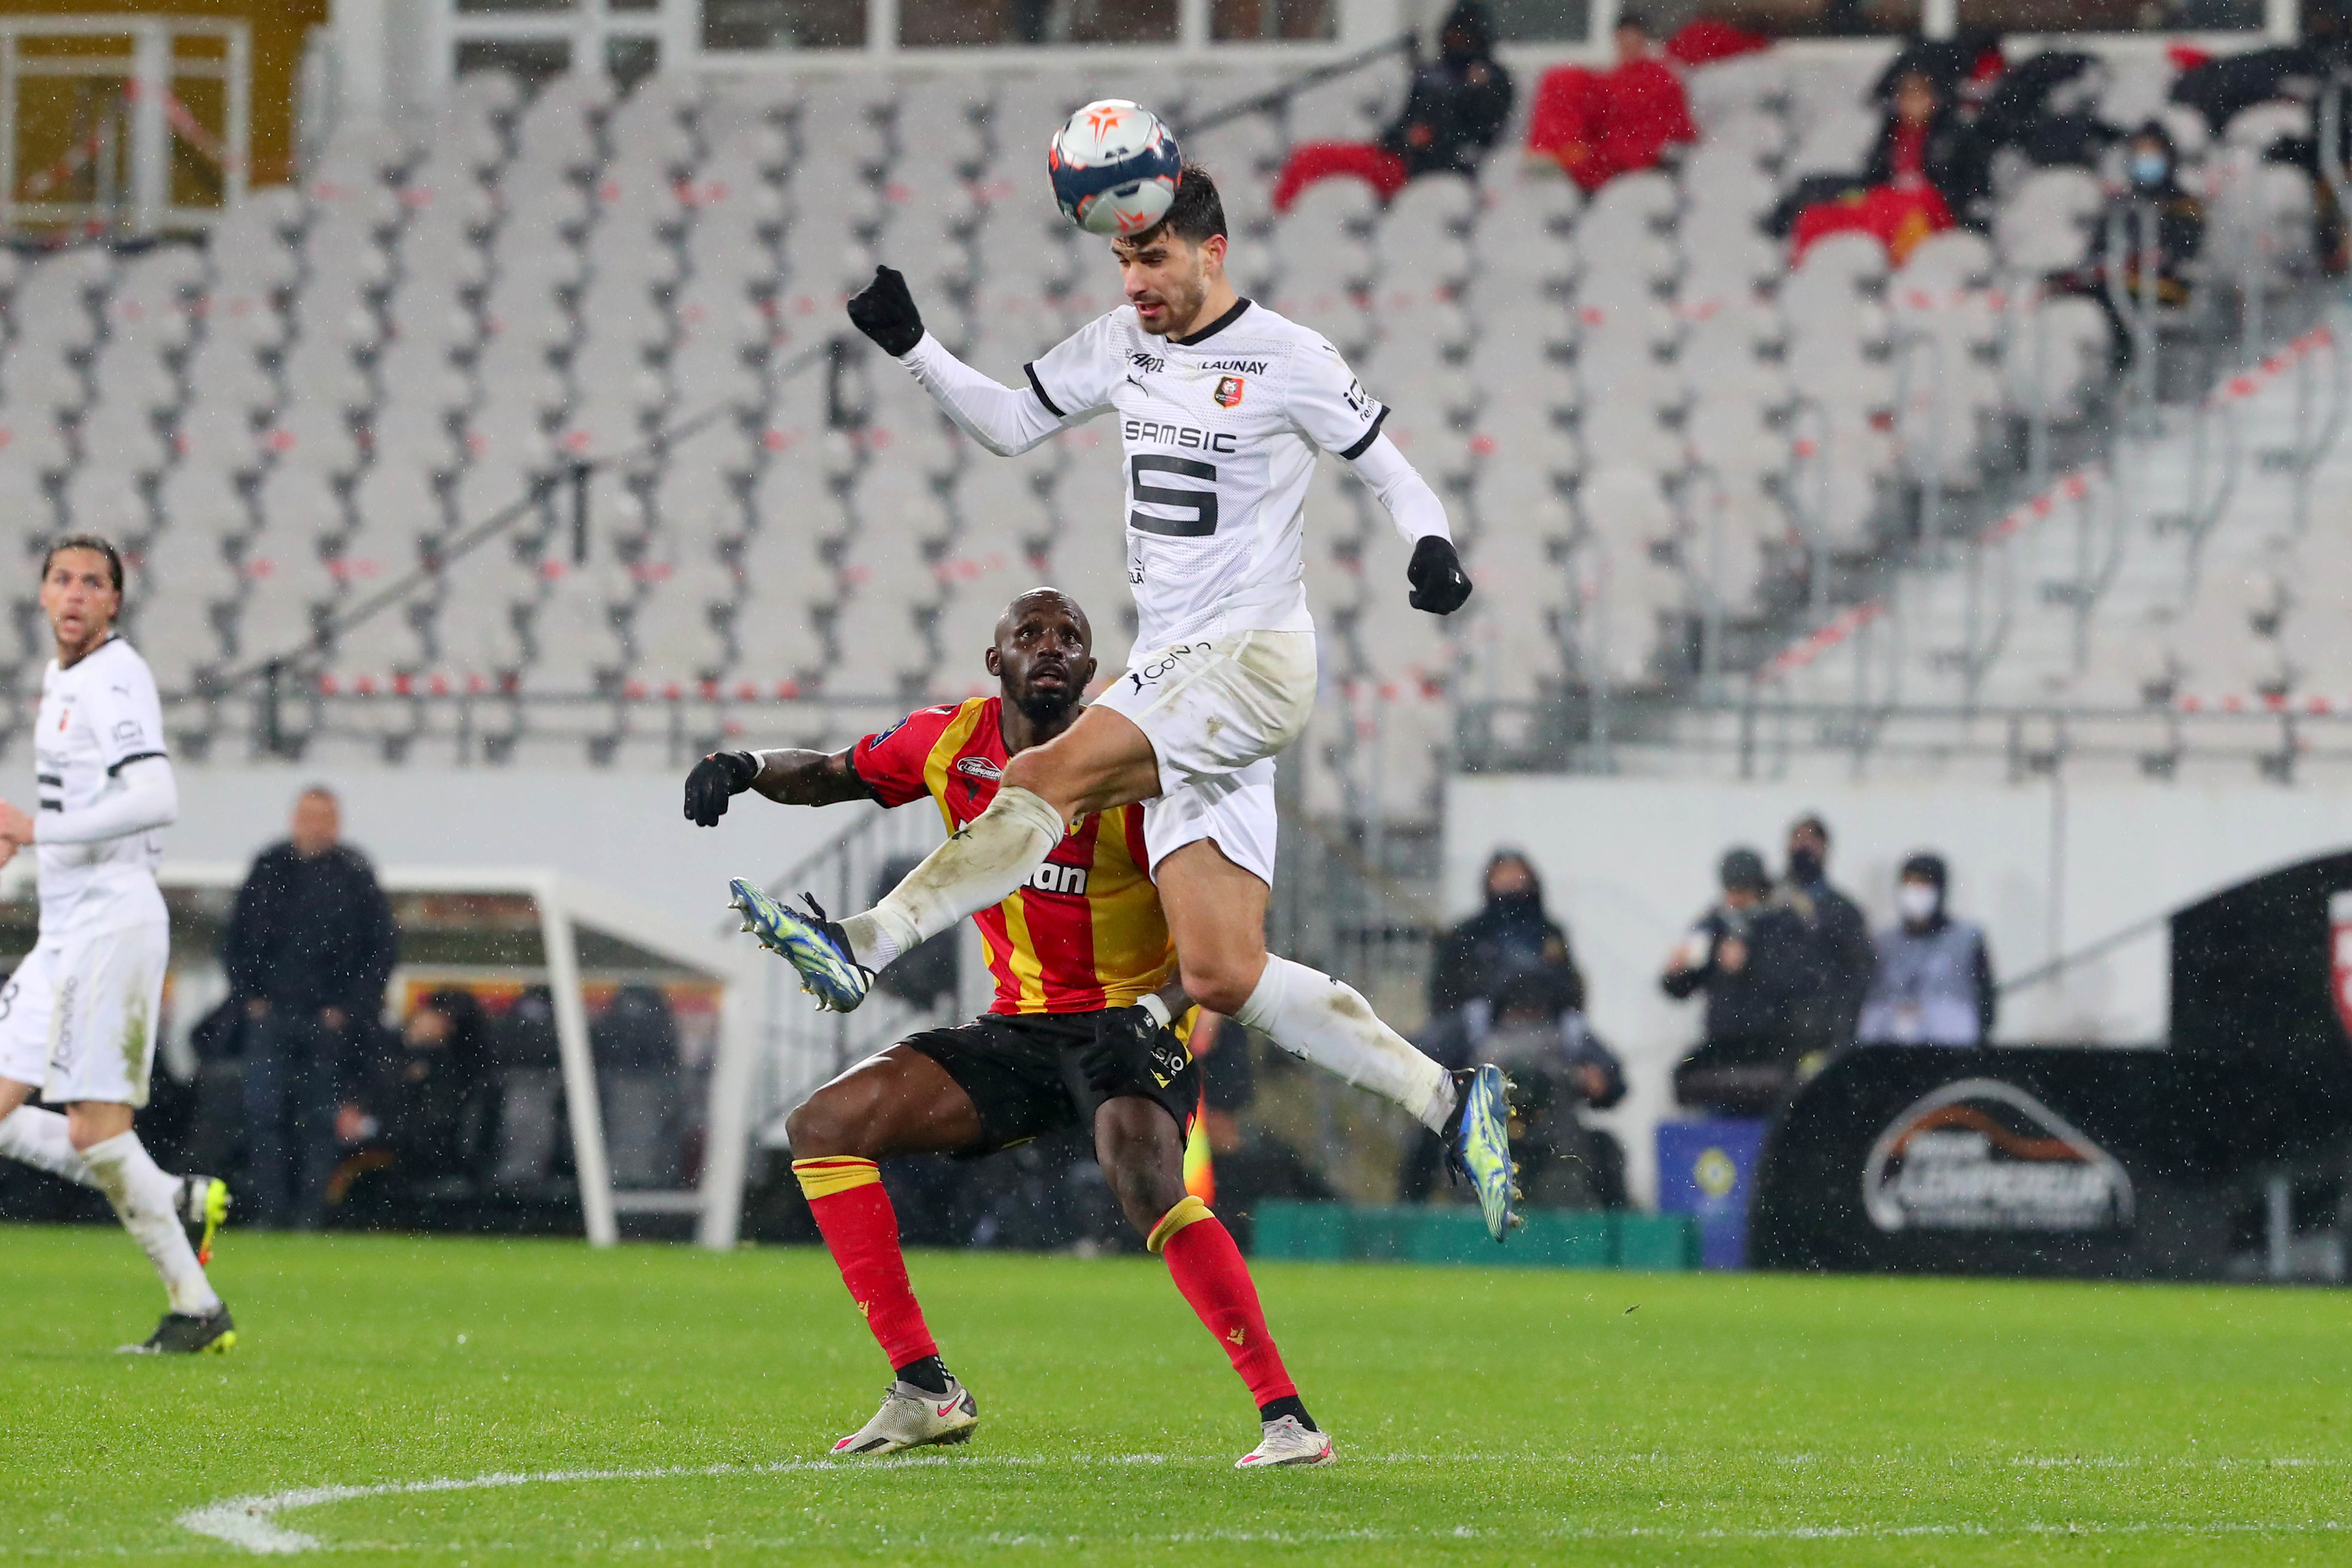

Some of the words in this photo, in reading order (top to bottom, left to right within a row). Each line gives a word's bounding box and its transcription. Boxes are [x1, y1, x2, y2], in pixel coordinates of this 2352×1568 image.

[1202, 361, 1268, 375] LAUNAY
[1125, 421, 1237, 453] SAMSIC
[1130, 453, 1219, 537] S
[963, 764, 1001, 778] LEMPEREUR
[1023, 862, 1086, 894] an
